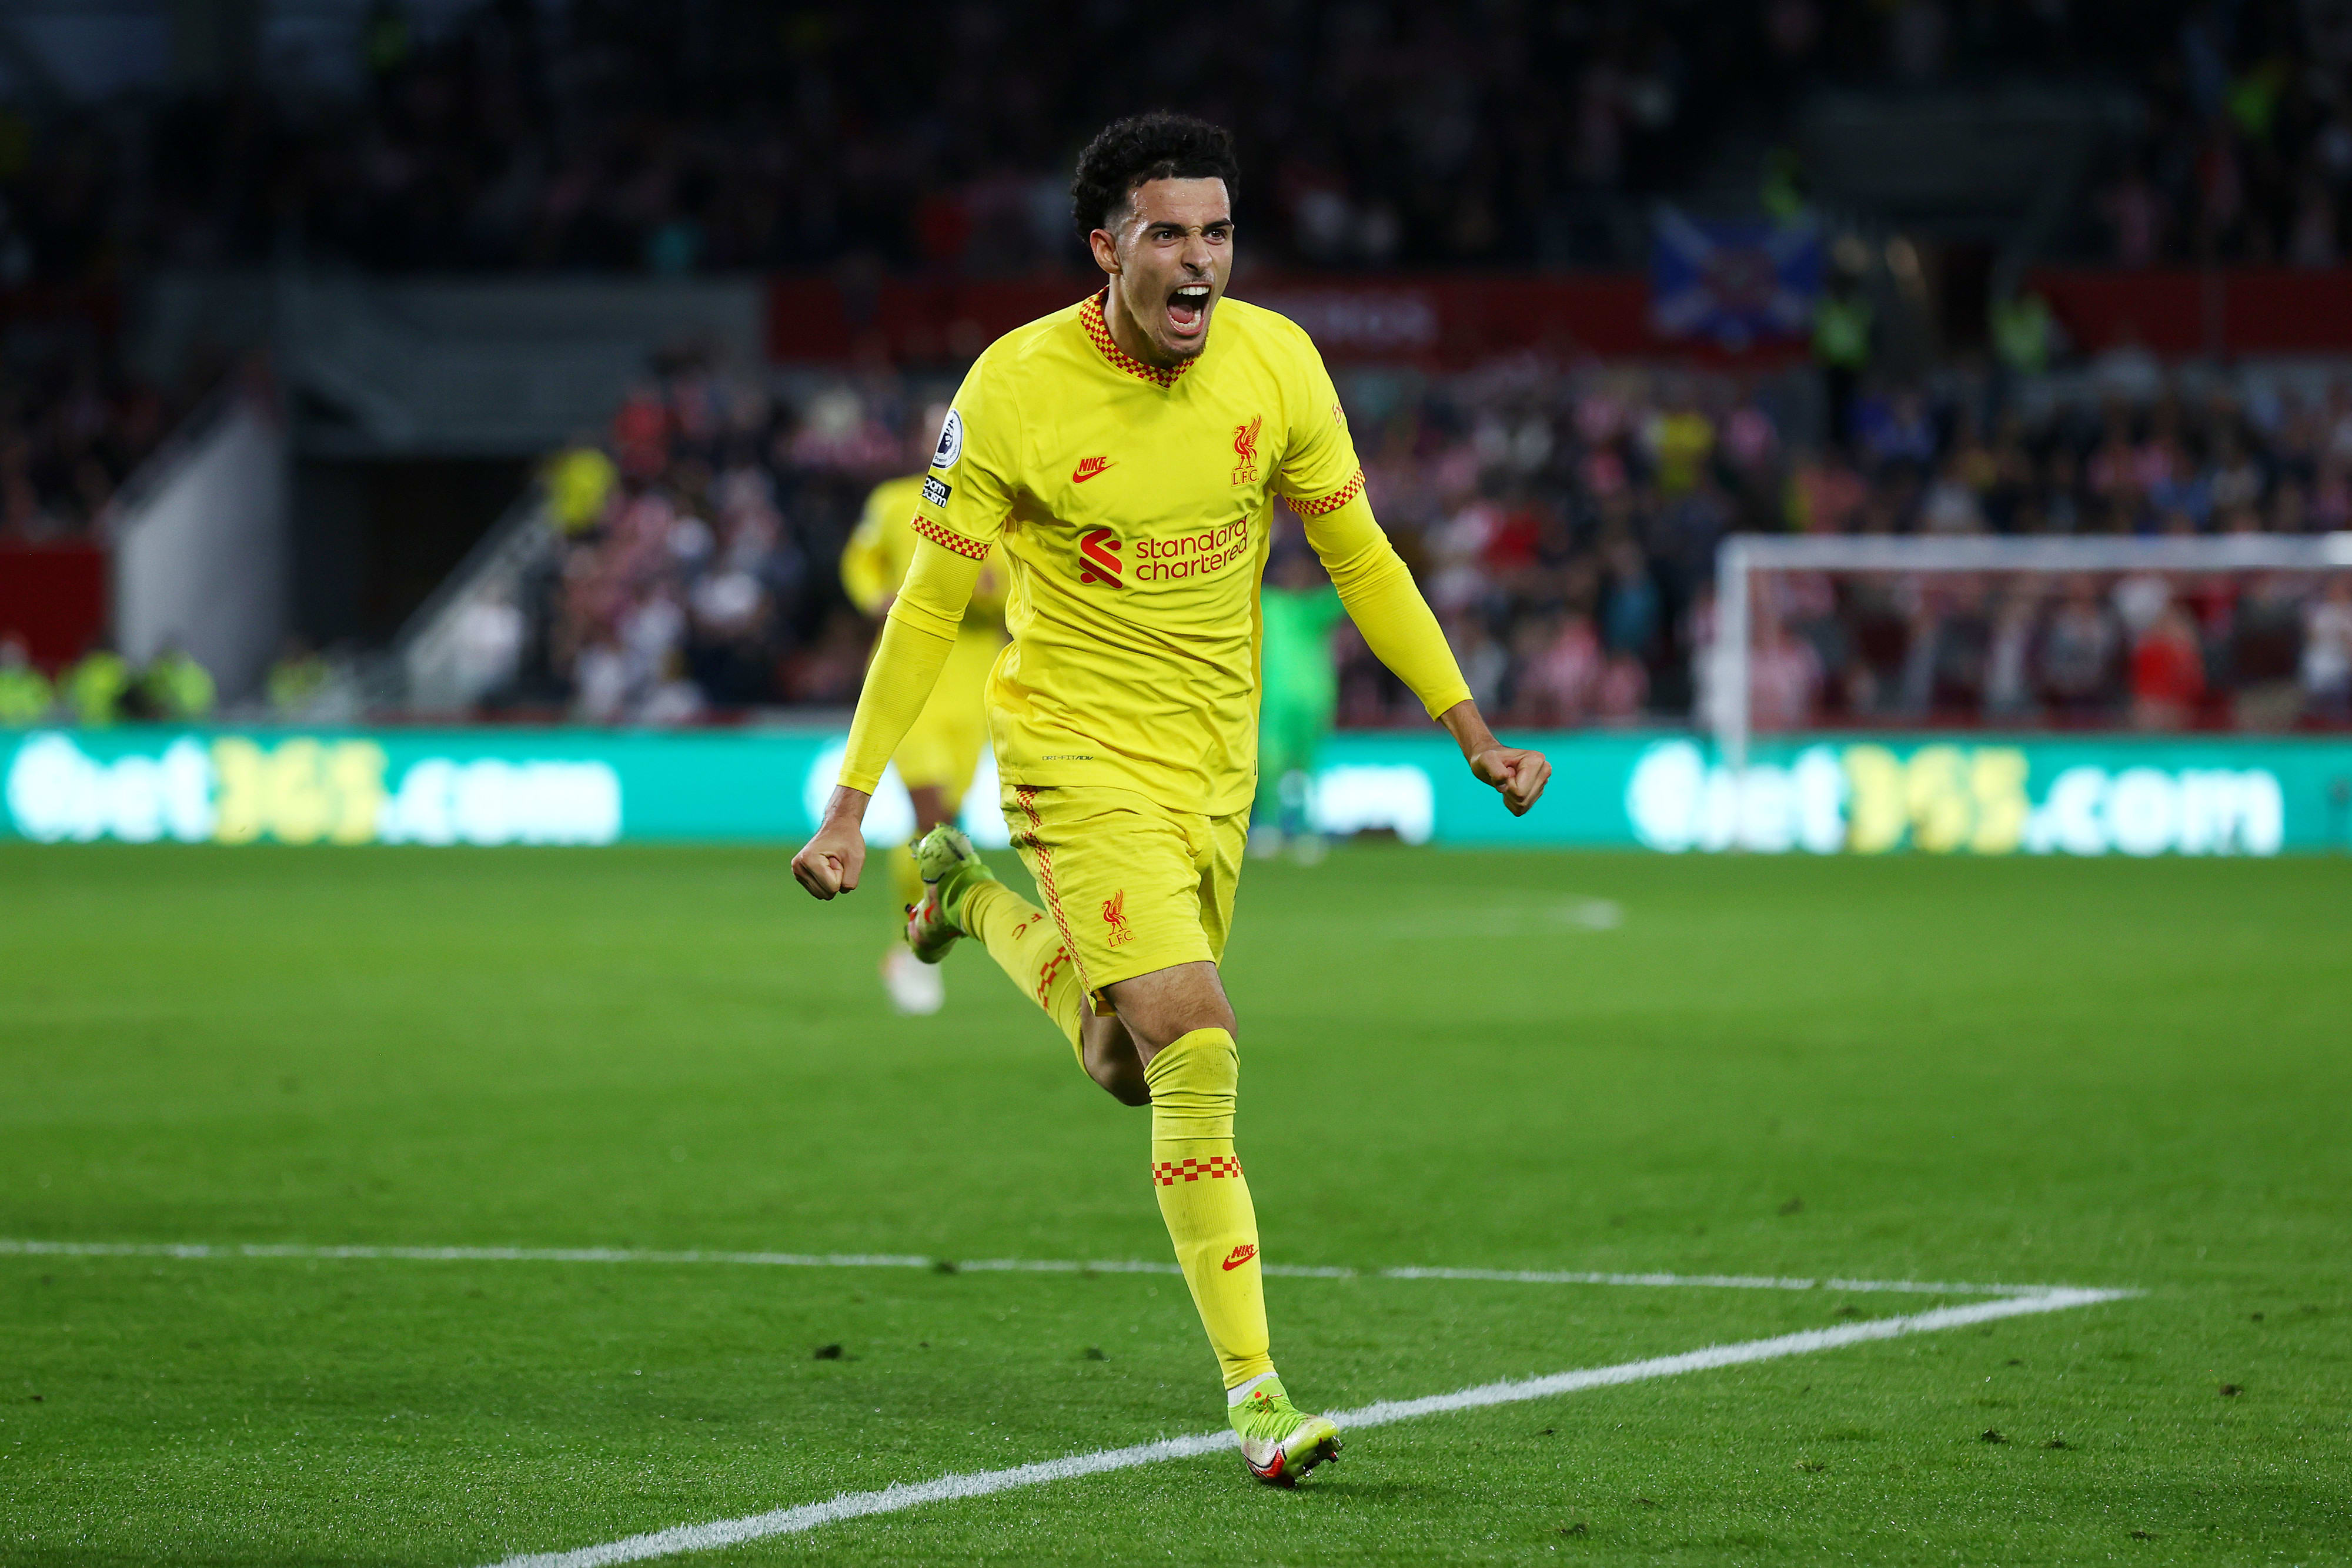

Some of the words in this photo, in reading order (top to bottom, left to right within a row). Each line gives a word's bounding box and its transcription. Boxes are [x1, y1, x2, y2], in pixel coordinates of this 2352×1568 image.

[1078, 456, 1107, 472] NIKE
[1136, 514, 1248, 559] standard
[1136, 531, 1248, 581] chartered
[1231, 1244, 1254, 1259] NIKE
